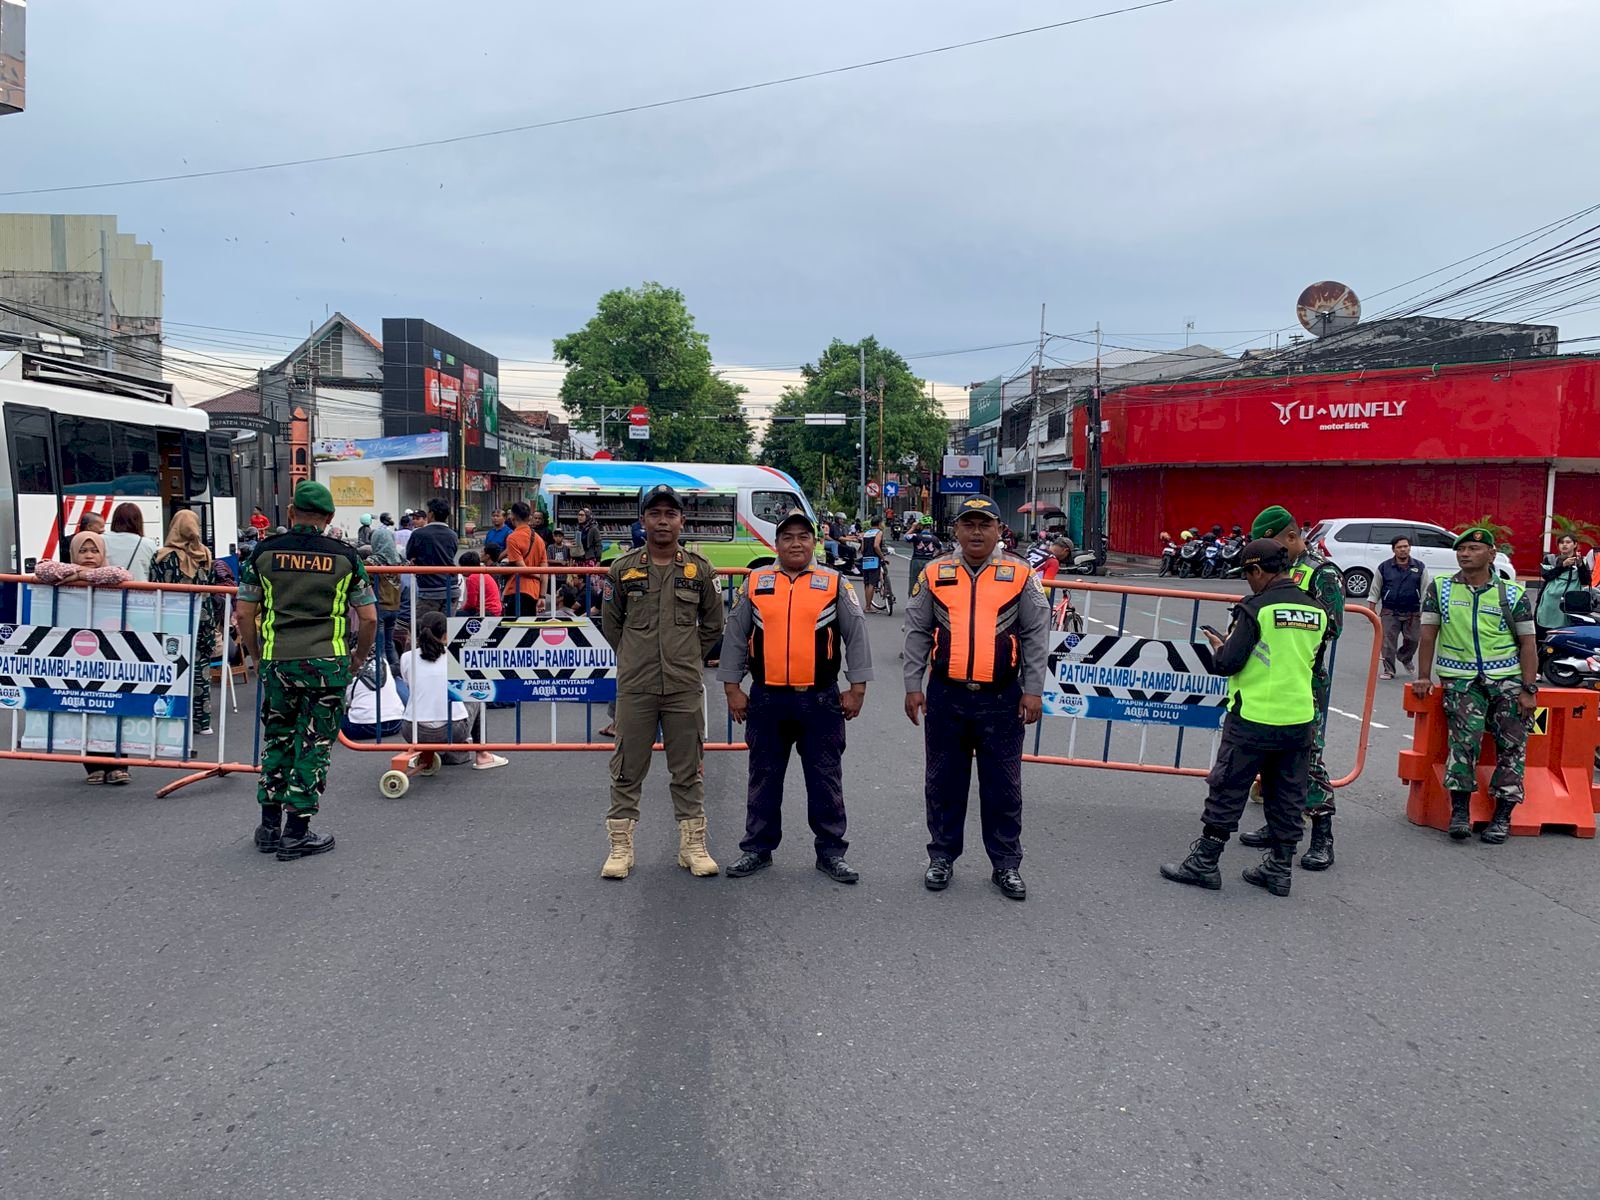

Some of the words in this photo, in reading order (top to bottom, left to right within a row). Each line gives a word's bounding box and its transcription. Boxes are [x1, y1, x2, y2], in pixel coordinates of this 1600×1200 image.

[948, 480, 973, 488] vivo
[276, 554, 333, 571] TNI-AD
[1276, 610, 1319, 625] RAPI
[464, 650, 500, 668] PATUHI
[503, 650, 581, 668] RAMBU-RAMBU
[584, 649, 606, 667] LALU
[34, 658, 110, 680] RAMBU-RAMBU
[113, 663, 135, 682] LALU
[138, 664, 172, 684] LINTAS
[1060, 663, 1097, 683] PATUHI
[1099, 667, 1177, 692] RAMBU-RAMBU
[1179, 674, 1203, 694] LALU
[1205, 676, 1229, 696] LINT
[466, 681, 491, 692] AQUA
[532, 686, 557, 697] AQUA
[560, 687, 587, 695] DULU
[80, 691, 122, 699] AKTIVITASMU
[1058, 695, 1083, 706] AQUA
[60, 697, 86, 708] AQUA
[88, 699, 115, 708] DULU
[1145, 701, 1188, 710] AKTIVITASMU
[1124, 707, 1149, 718] AQUA
[1152, 709, 1179, 719] DULU
